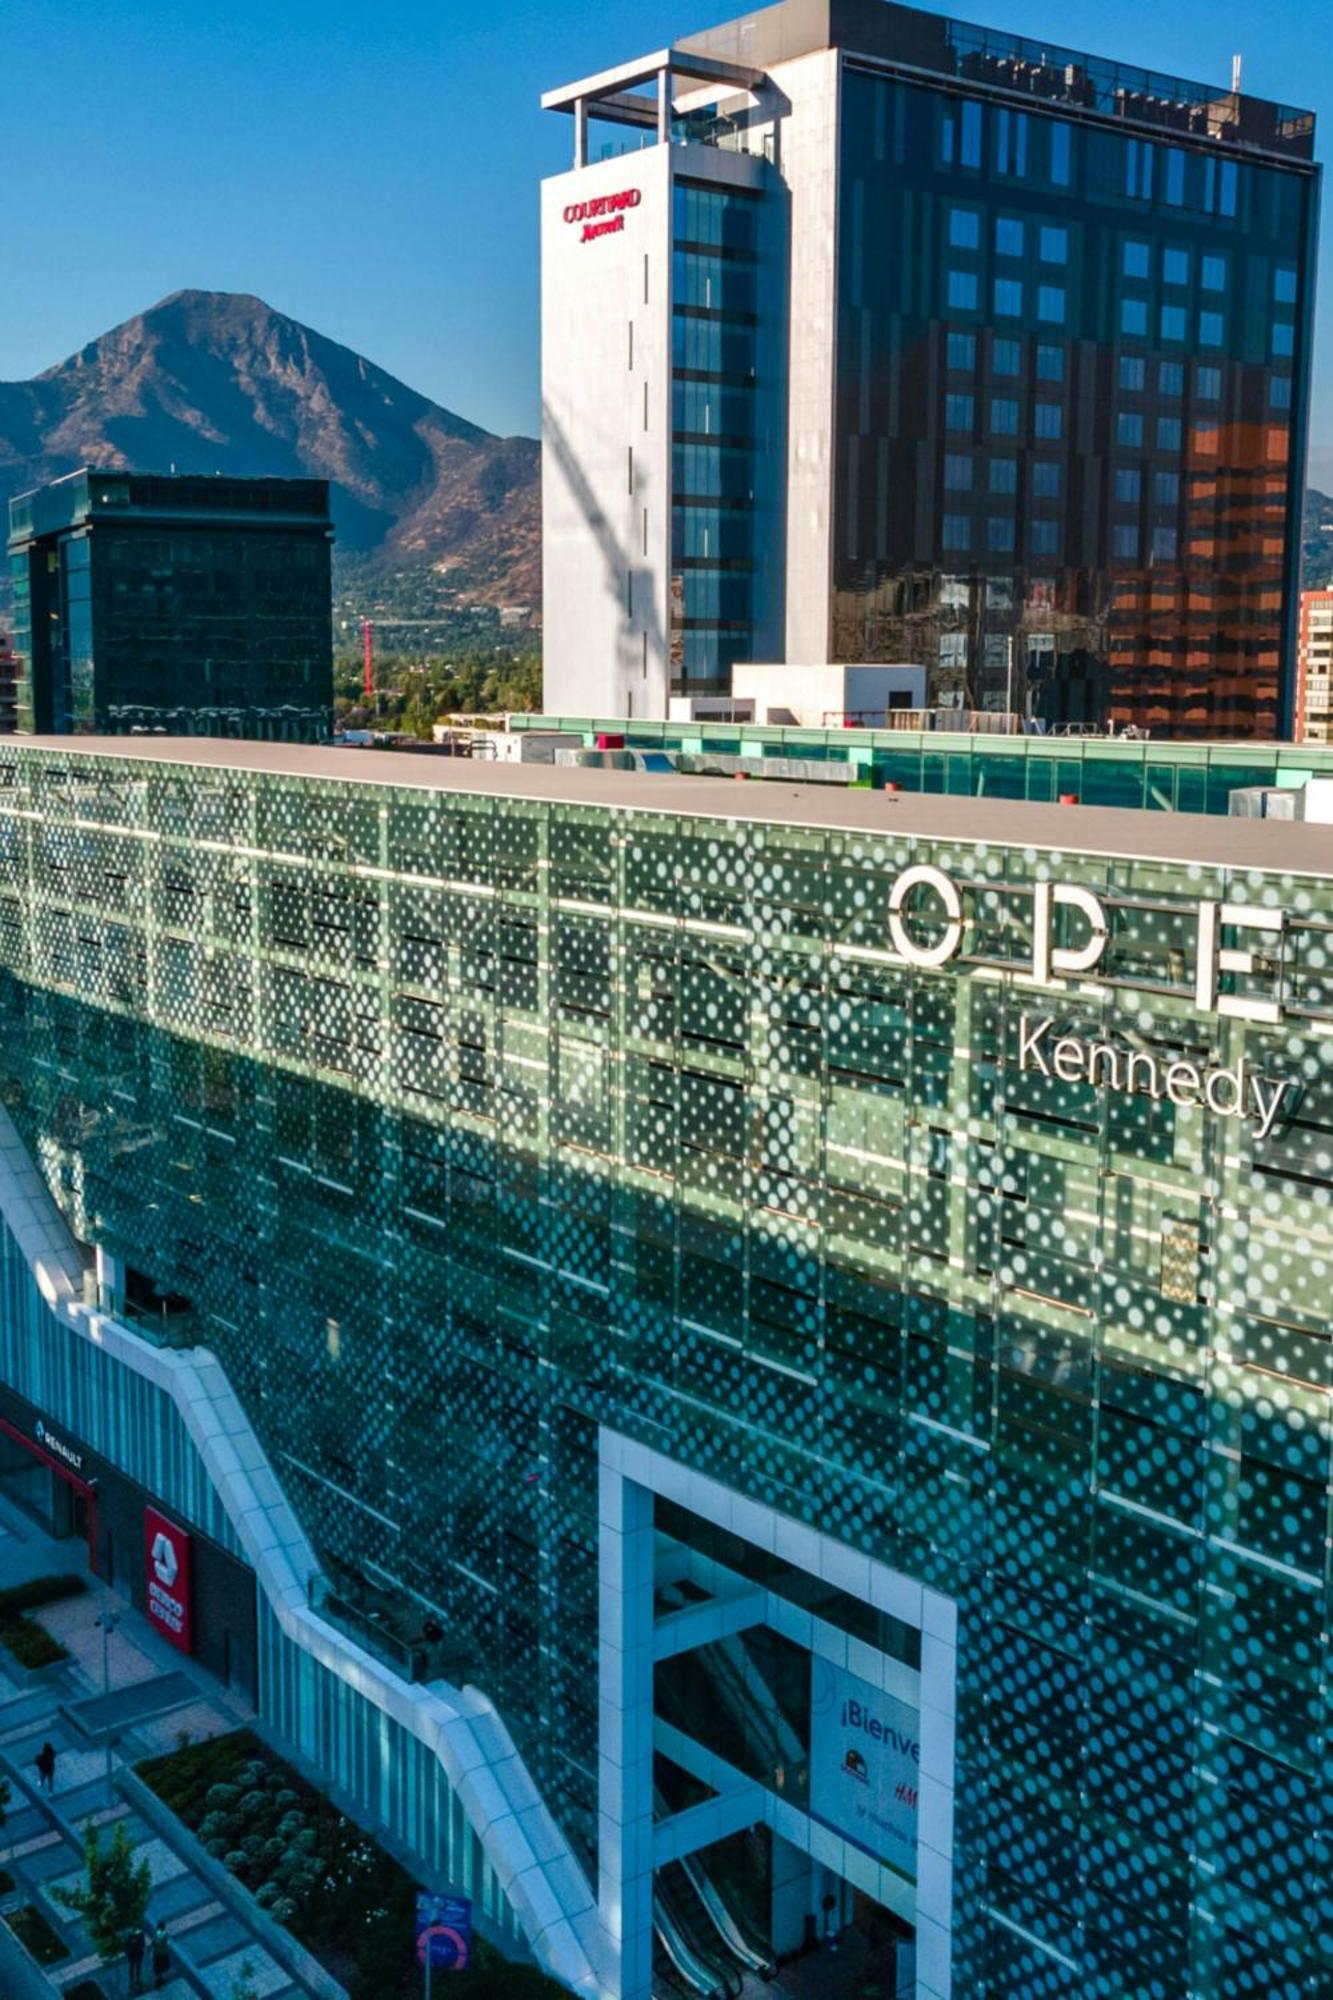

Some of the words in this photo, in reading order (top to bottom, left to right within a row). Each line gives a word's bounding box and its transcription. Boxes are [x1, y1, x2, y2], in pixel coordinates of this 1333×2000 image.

[563, 188, 641, 224] COURTYARD
[1018, 1013, 1290, 1139] Kennedy
[45, 1432, 82, 1469] RENAULT
